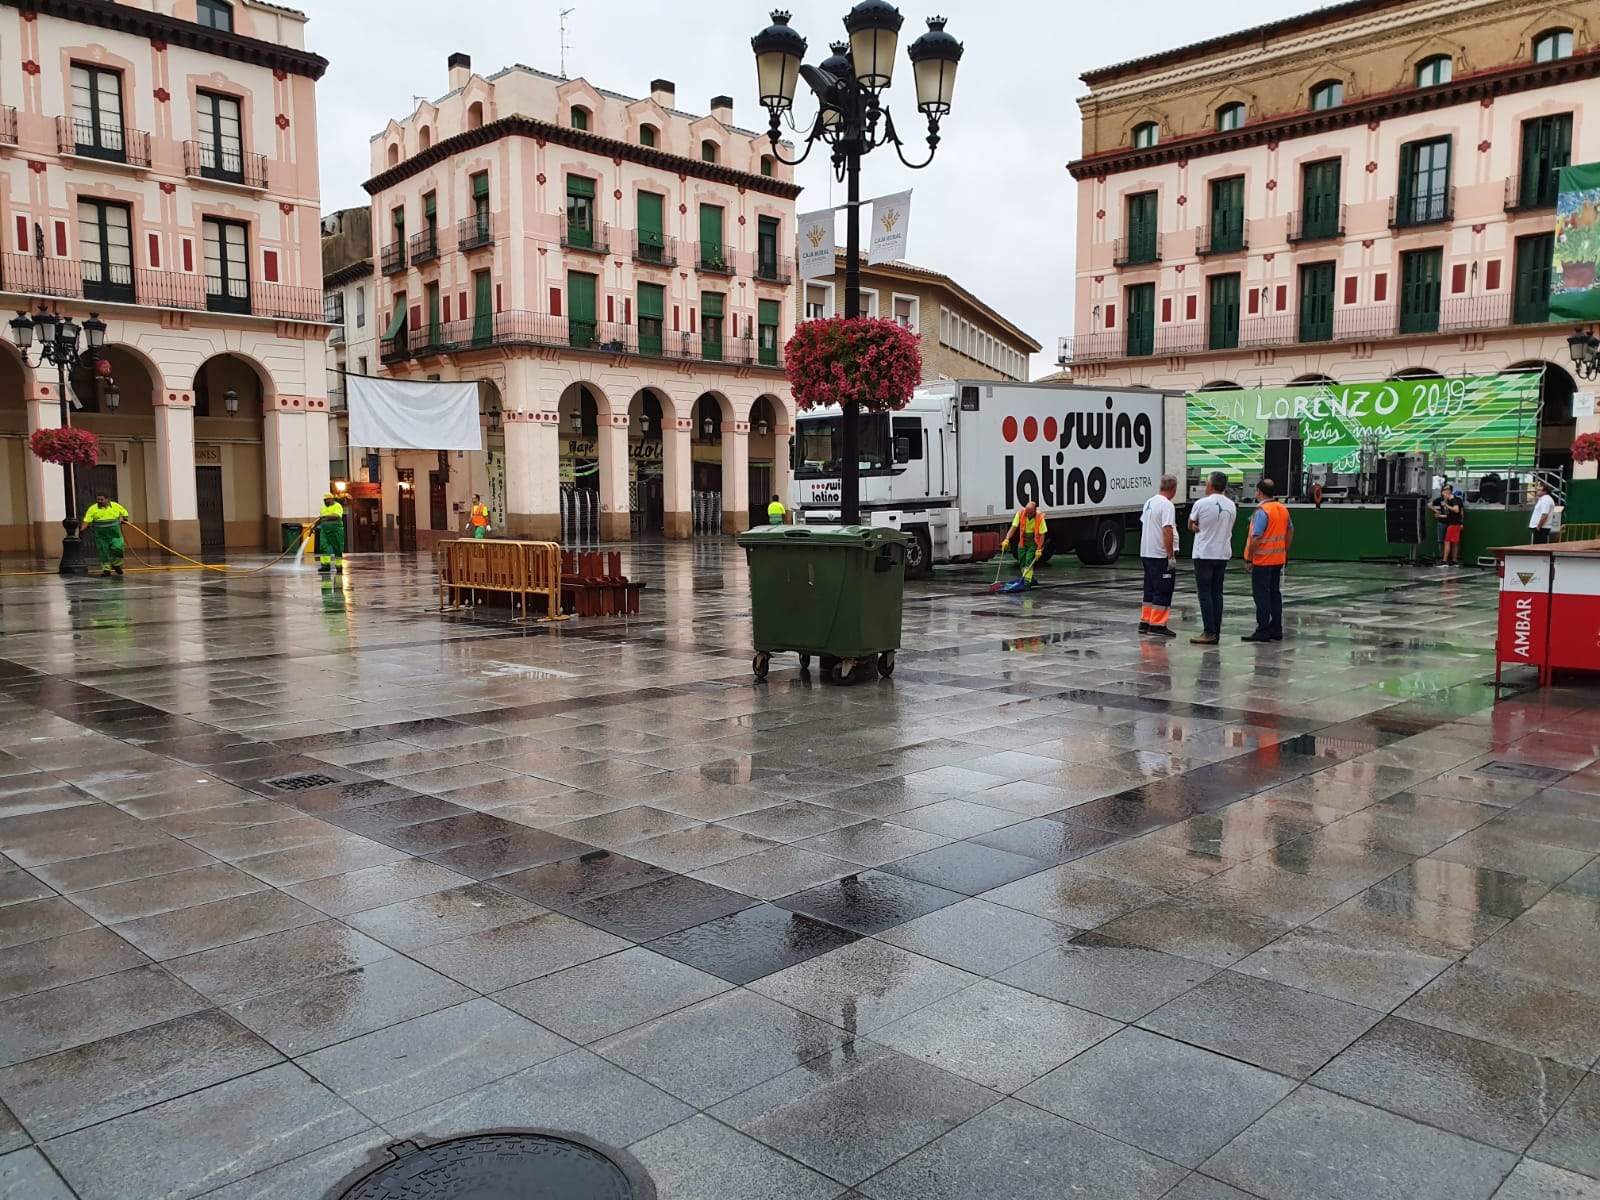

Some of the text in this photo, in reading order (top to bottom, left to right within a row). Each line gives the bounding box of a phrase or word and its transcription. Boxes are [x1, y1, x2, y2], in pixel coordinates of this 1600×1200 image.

[1256, 386, 1399, 421] LORENZO
[1413, 380, 1465, 417] 2019
[1060, 396, 1152, 464] swing
[812, 491, 839, 502] latino
[1005, 451, 1107, 509] latino
[1110, 476, 1152, 490] ORQUESTRA
[1514, 597, 1532, 657] AMBAR
